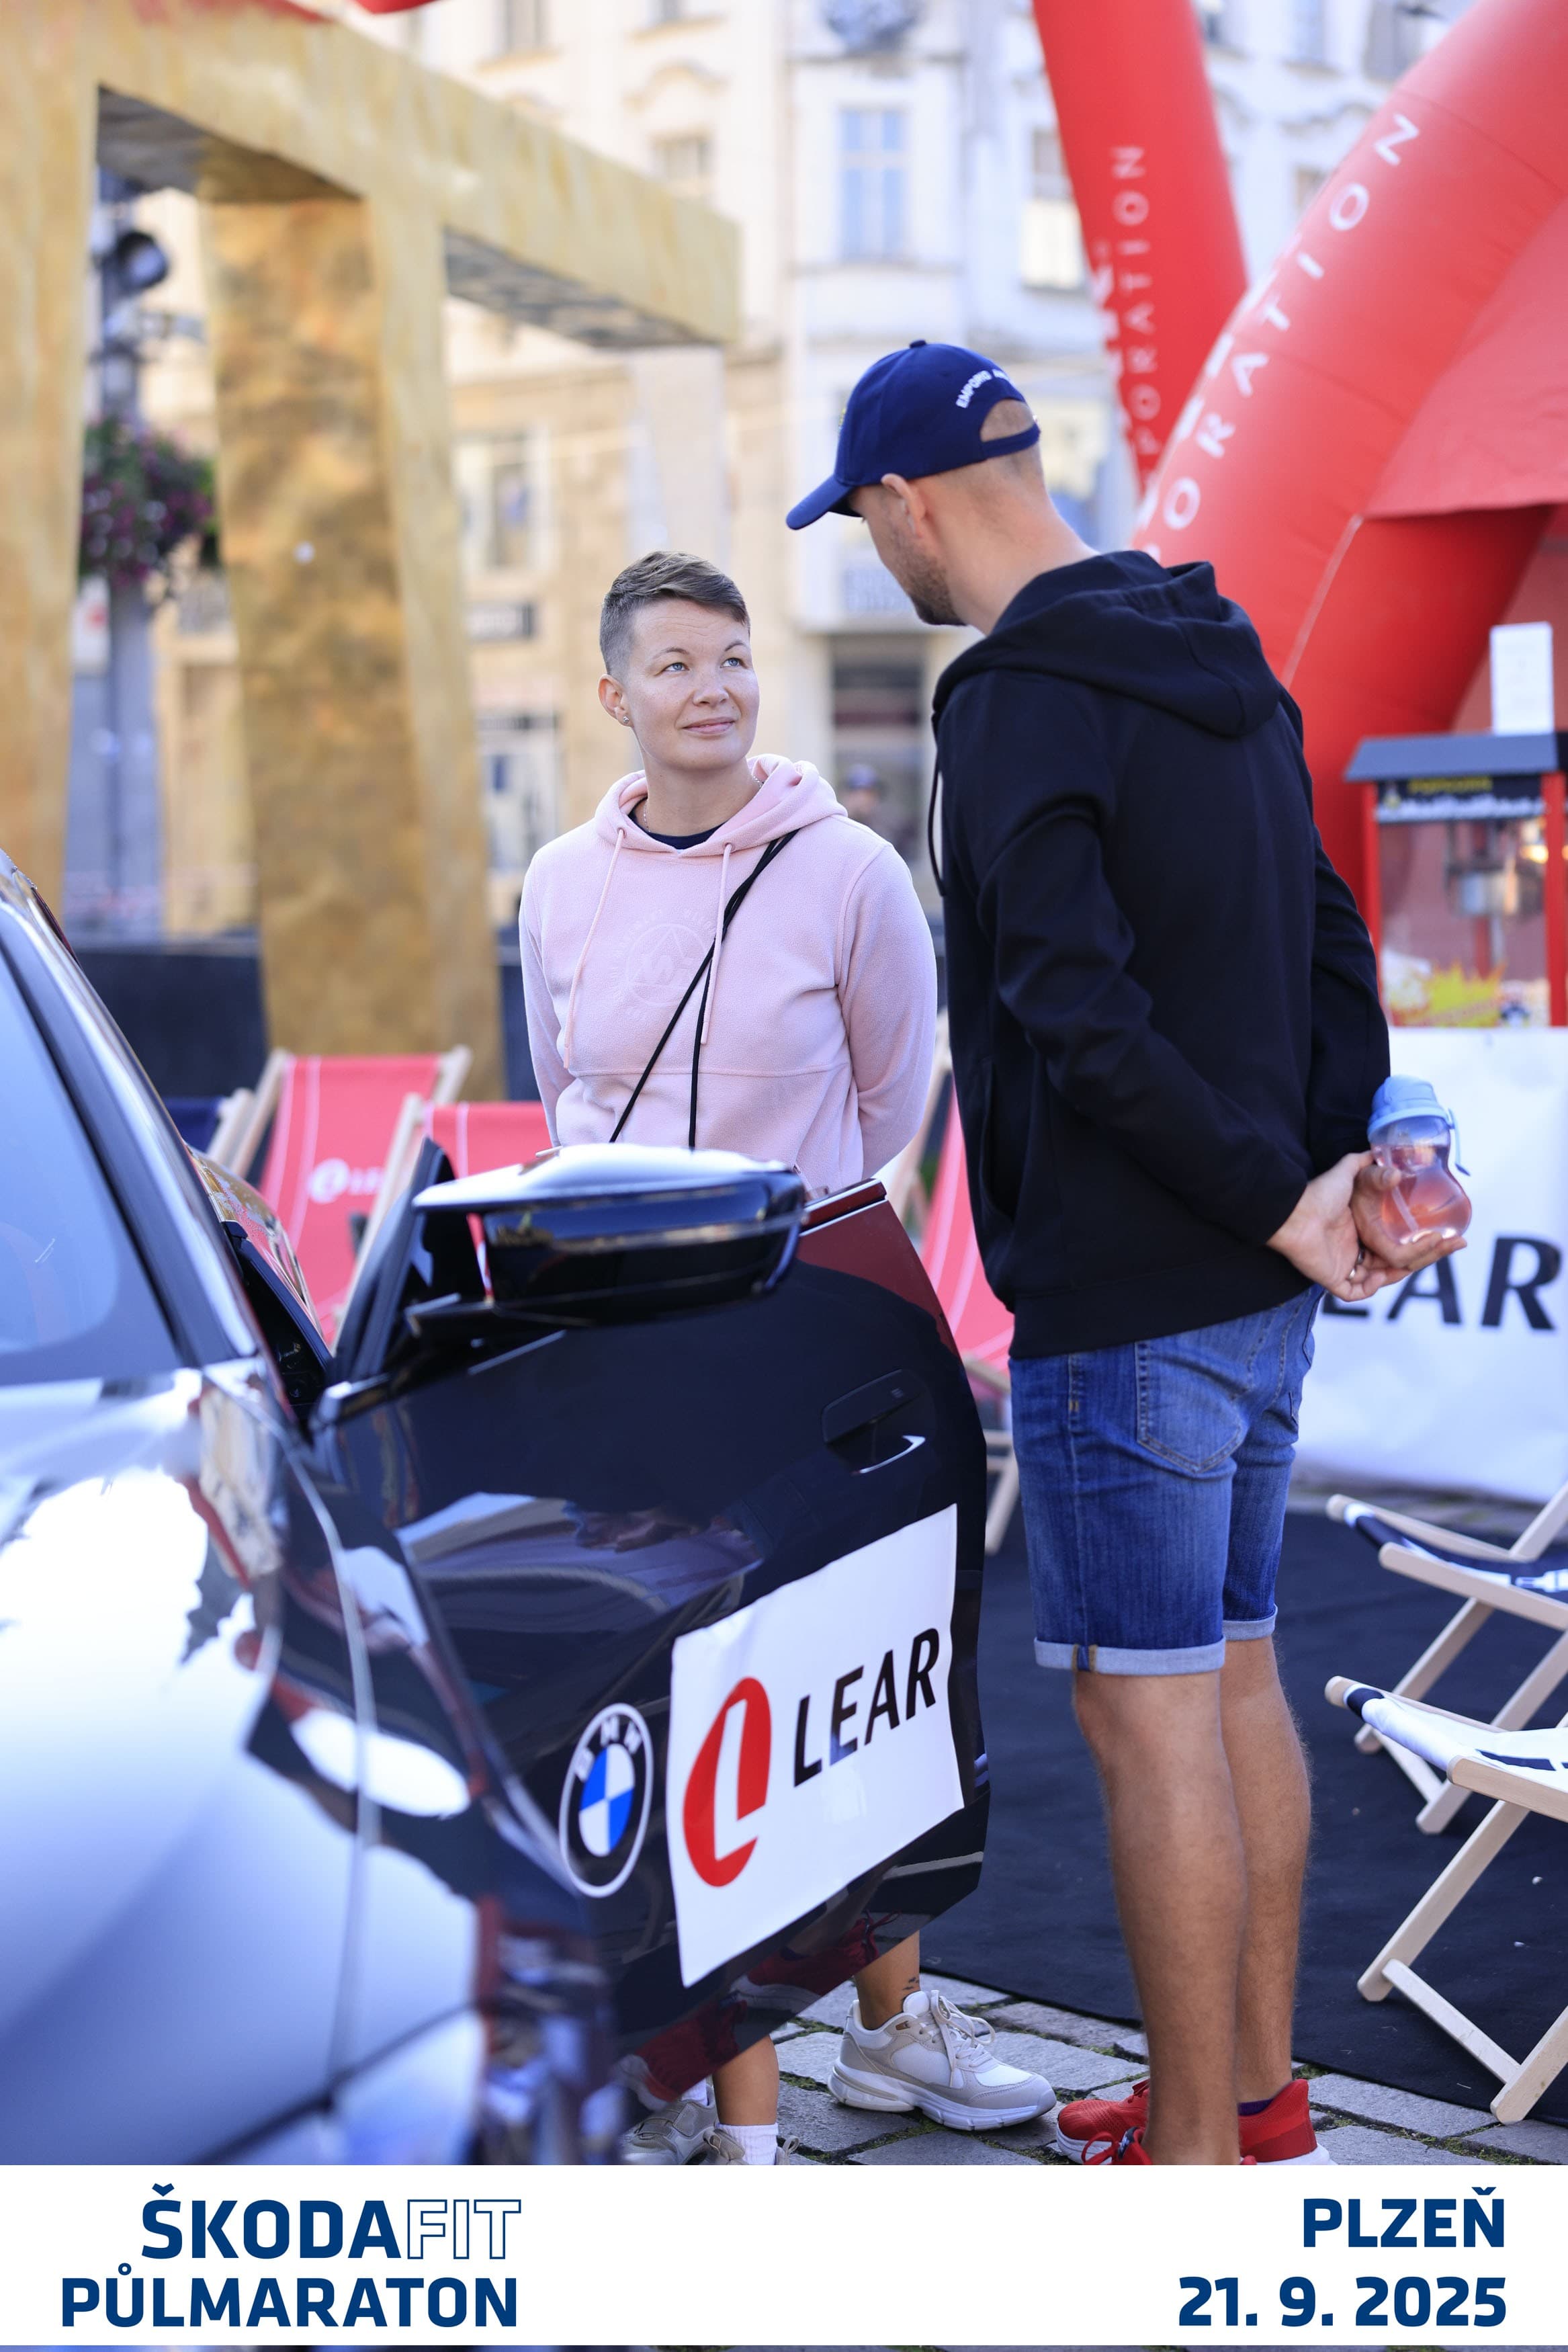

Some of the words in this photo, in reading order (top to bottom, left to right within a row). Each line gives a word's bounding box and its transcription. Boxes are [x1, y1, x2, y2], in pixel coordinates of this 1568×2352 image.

[956, 371, 992, 408] EMPORIO
[1322, 1236, 1562, 1331] AR
[573, 1714, 642, 1782] BMW
[793, 1627, 940, 1788] LEAR
